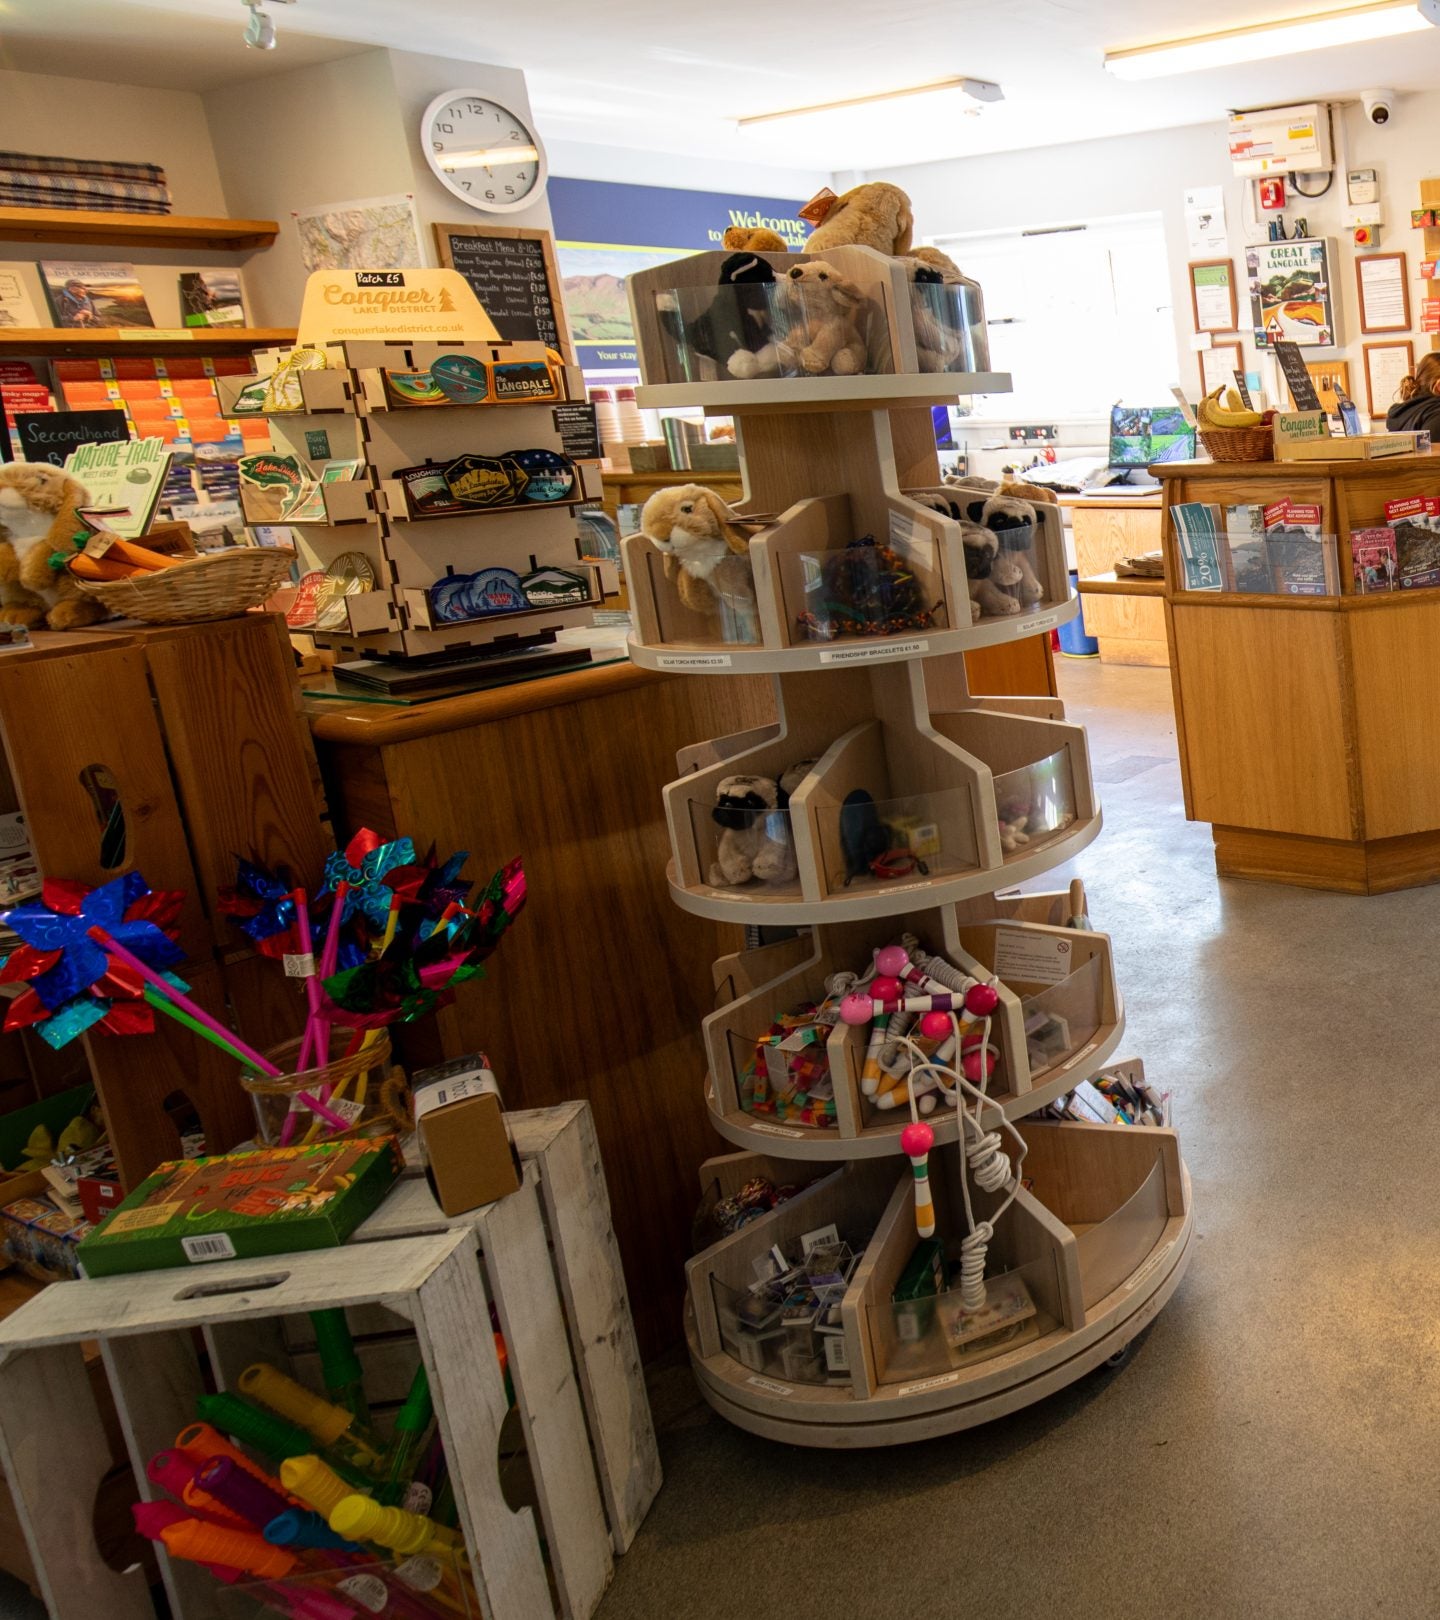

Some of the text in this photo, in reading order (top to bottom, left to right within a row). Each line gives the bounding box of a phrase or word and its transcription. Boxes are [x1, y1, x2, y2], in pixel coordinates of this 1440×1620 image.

[449, 108, 462, 119] 11
[467, 104, 483, 115] 12
[495, 113, 500, 122] 1
[436, 123, 453, 134] 10
[510, 131, 520, 140] 2
[433, 142, 443, 151] 9
[516, 172, 526, 180] 4
[462, 181, 472, 191] 7
[504, 185, 514, 195] 5
[485, 190, 495, 199] 6
[728, 209, 805, 234] Welcome
[708, 229, 722, 241] to
[452, 238, 494, 253] Breakfast
[495, 242, 515, 254] Menu
[1270, 247, 1304, 259] GREAT
[1267, 258, 1308, 269] LANGDALE
[357, 273, 400, 285] Patch £5
[323, 284, 435, 312] Conquer
[353, 305, 437, 315] LAKE DISTRICT
[332, 322, 465, 336] conquerlakedistrict.co.uk
[597, 351, 636, 363] Your stay
[497, 378, 550, 393] LANGDALE
[1280, 415, 1318, 436] Conquer
[27, 421, 120, 443] Secondhand
[72, 437, 163, 472] NATURE TRAIL
[1389, 501, 1409, 510] PLANNING
[1198, 551, 1213, 585] 20%
[831, 651, 868, 660] FRIENDSHIP
[869, 646, 905, 656] BRACELETS
[219, 1164, 291, 1189] BUG
